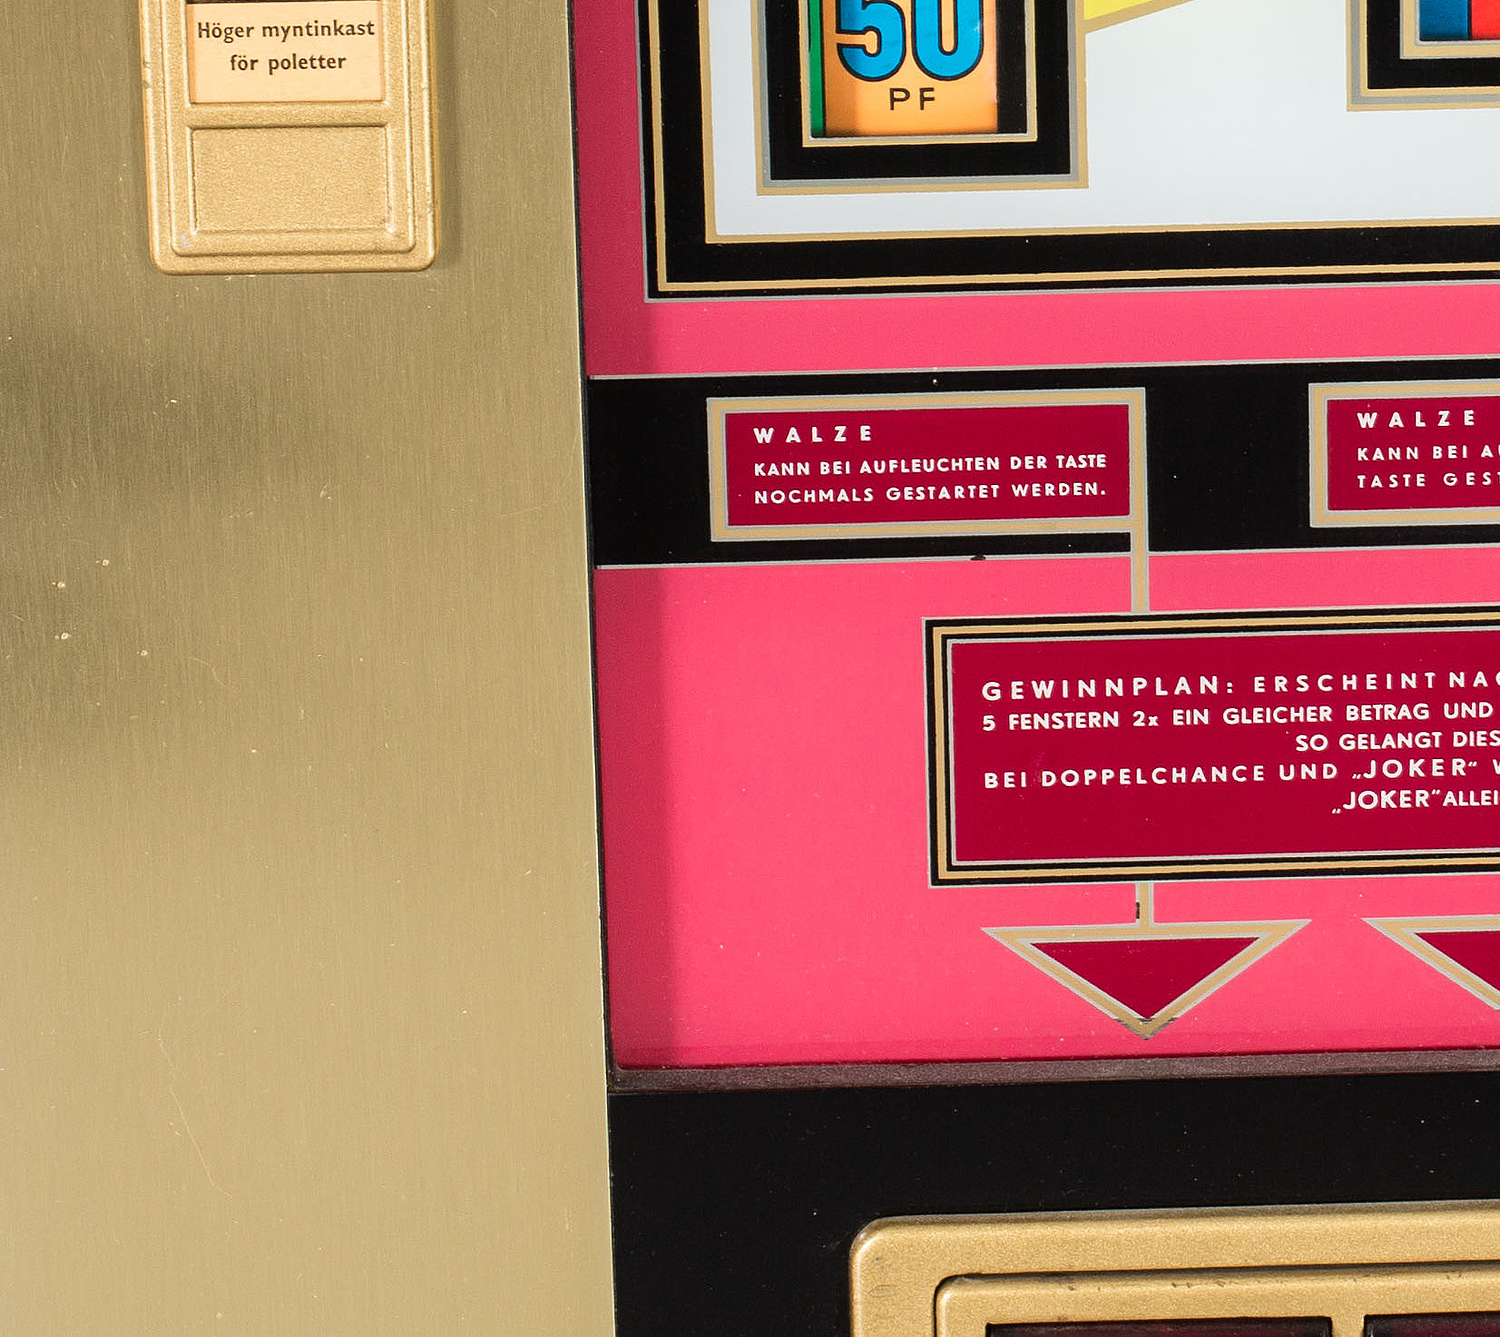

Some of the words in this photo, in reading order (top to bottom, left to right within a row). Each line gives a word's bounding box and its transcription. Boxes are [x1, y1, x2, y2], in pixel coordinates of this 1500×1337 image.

[197, 21, 255, 44] Höger
[262, 19, 375, 43] myntinkast
[230, 54, 259, 71] för
[268, 52, 347, 76] poletter
[889, 87, 936, 110] PF
[1356, 409, 1475, 429] WALZE
[753, 425, 871, 444] WALZE
[1357, 446, 1419, 461] KANN
[1432, 445, 1467, 460] BEI
[754, 461, 810, 477] KANN
[820, 460, 850, 475] BEI
[859, 456, 1000, 474] AUFLEUCHTEN
[1010, 455, 1047, 470] DER
[1055, 453, 1106, 469] TASTE
[1357, 473, 1425, 489] TASTE
[754, 487, 874, 504] NOCHMALS
[886, 484, 1000, 501] GESTARTET
[1011, 482, 1106, 497] WERDEN.
[981, 675, 1233, 701] GEWINNPLAN:
[1254, 672, 1436, 693] ERSCHEINT
[982, 714, 996, 732] 5
[1008, 710, 1119, 731] FENSTERN
[1172, 708, 1209, 726] EIN
[1222, 705, 1332, 725] GLEICHER
[1346, 703, 1430, 722] BETRAG
[1443, 701, 1494, 719] UND
[1295, 734, 1329, 752] SO
[1338, 731, 1443, 751] GELANGT
[984, 771, 1027, 789] BEI
[1041, 765, 1264, 787] DOPPELCHANCE
[1279, 763, 1338, 781] UND
